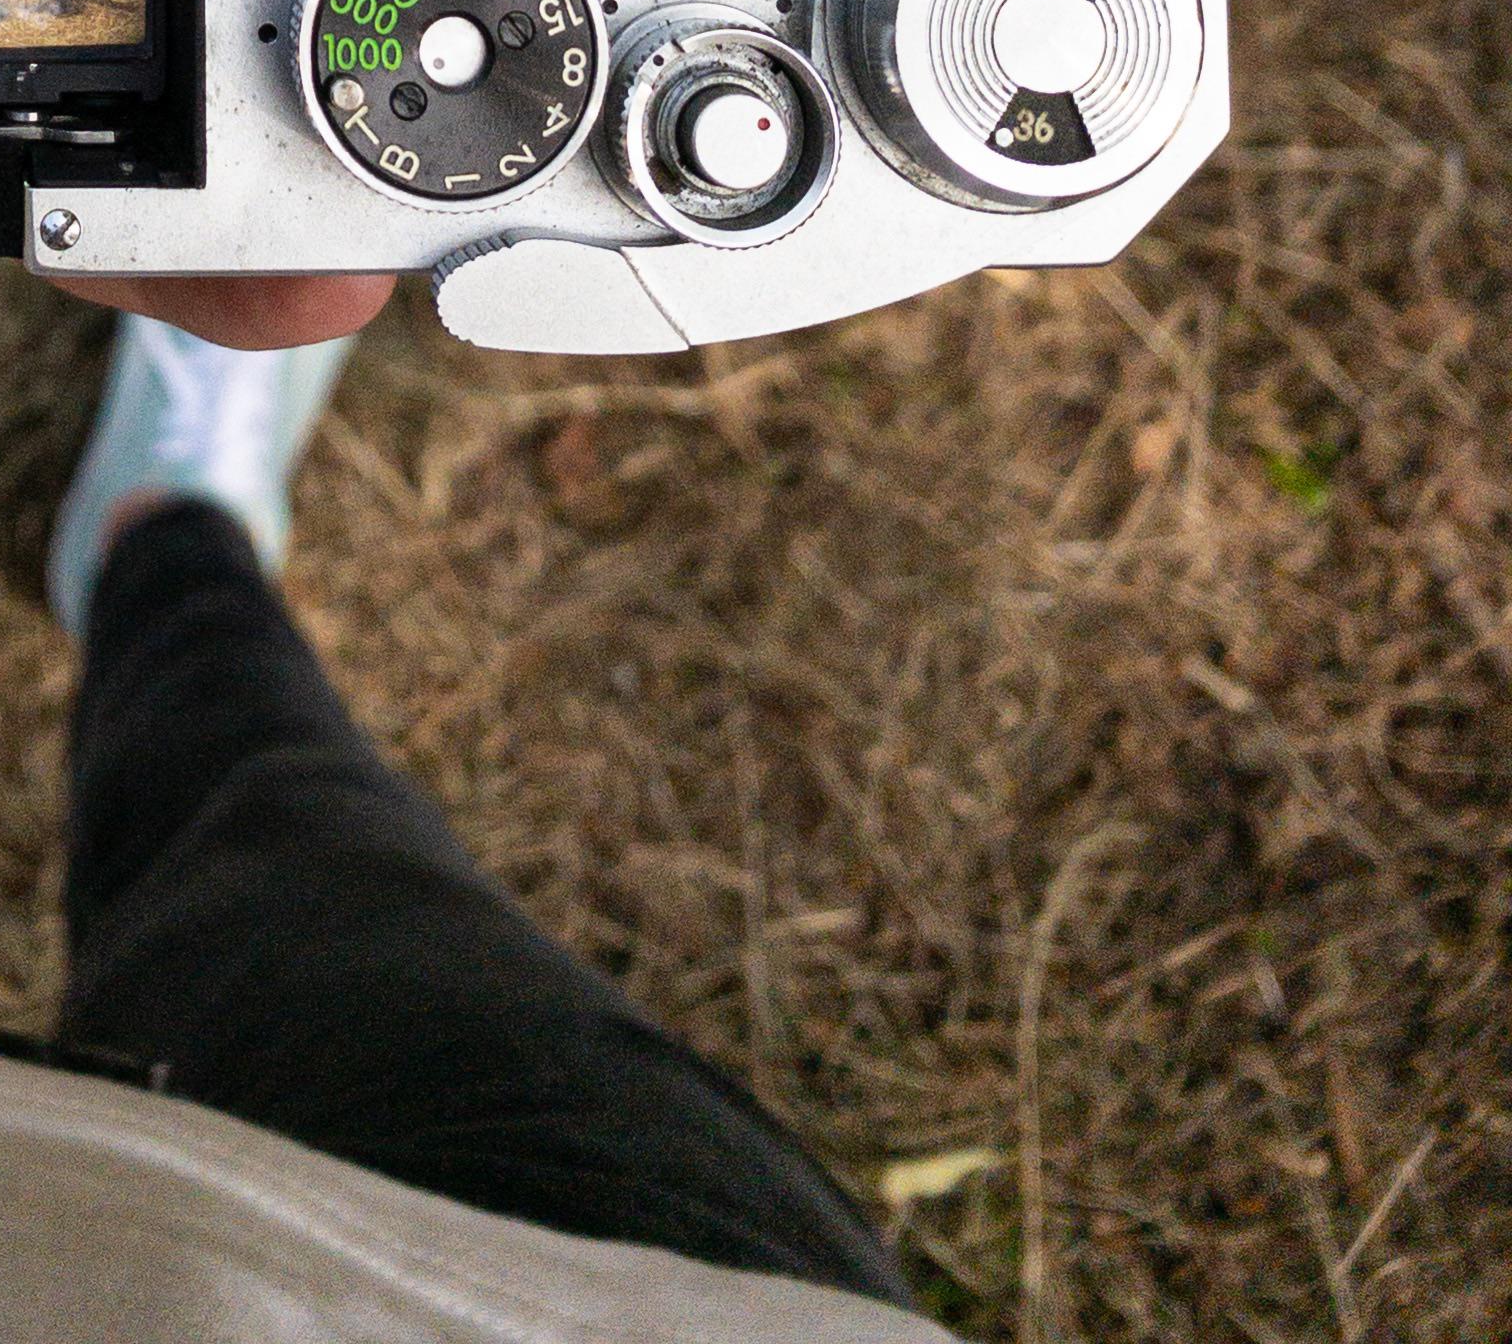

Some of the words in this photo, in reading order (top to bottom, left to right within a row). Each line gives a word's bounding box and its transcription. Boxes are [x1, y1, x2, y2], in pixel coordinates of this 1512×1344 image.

[323, 32, 404, 72] 1000
[561, 46, 588, 88] 8
[344, 105, 381, 145] T
[541, 102, 572, 139] 4
[1012, 108, 1056, 144] 36
[378, 144, 422, 182] B
[499, 143, 538, 178] 2
[444, 172, 482, 191] 1
